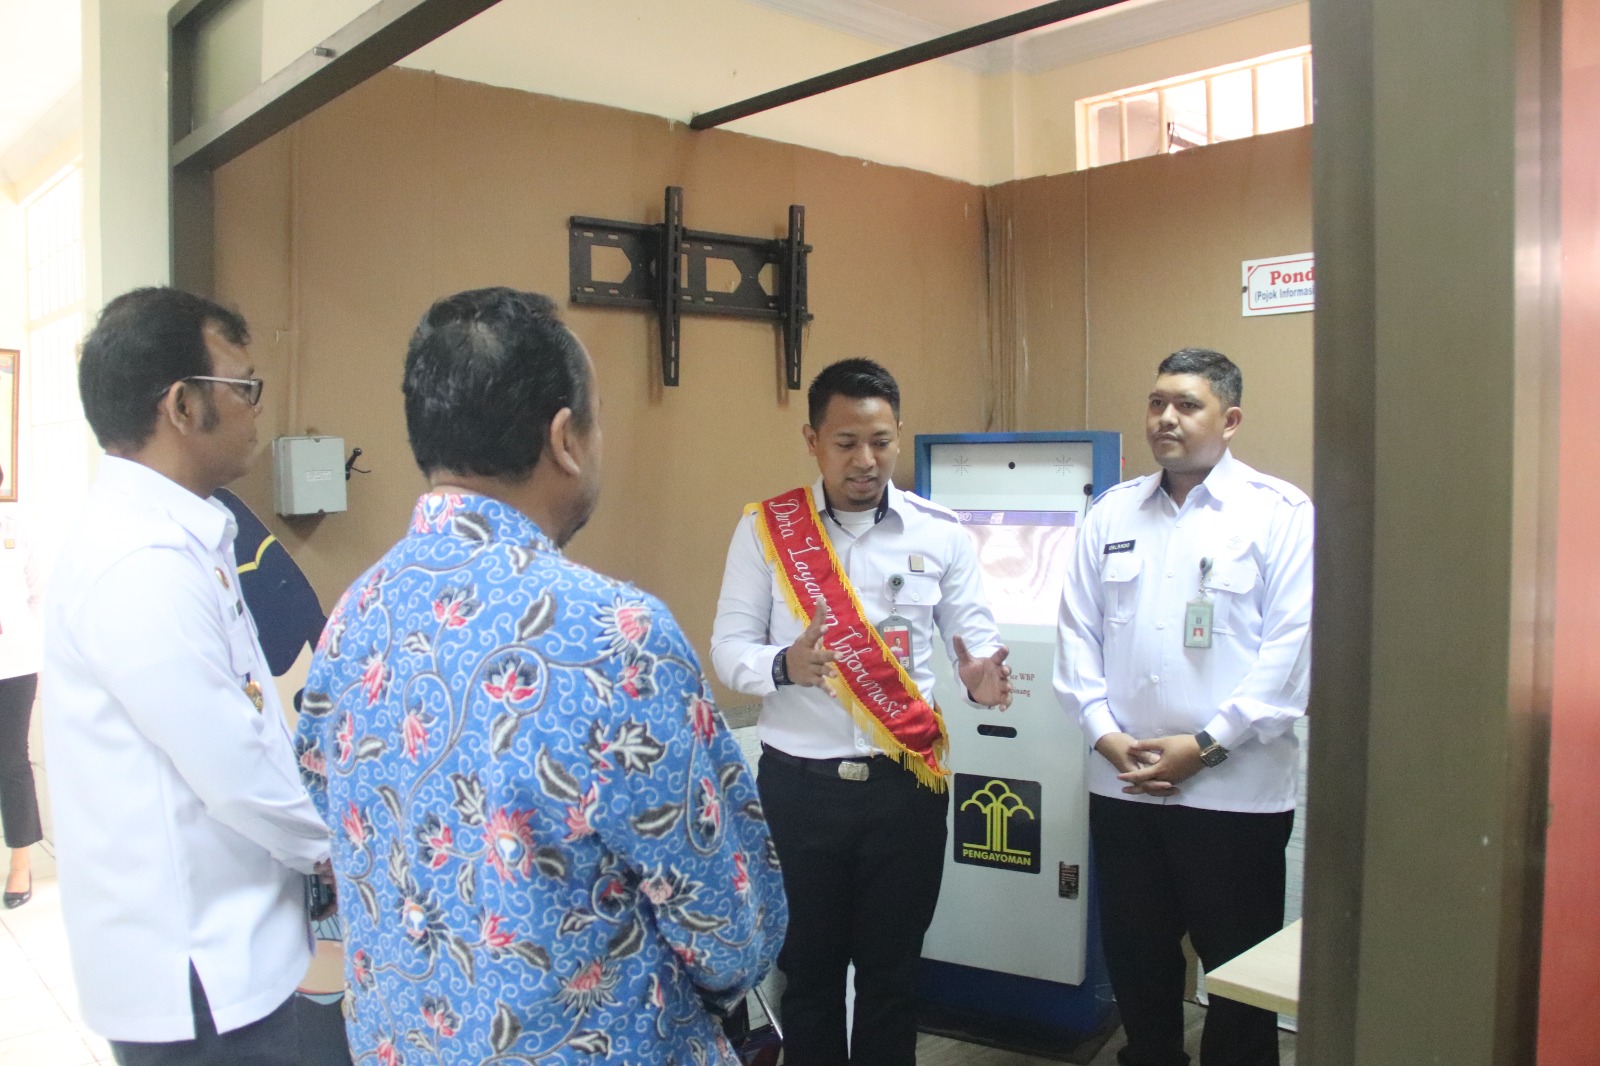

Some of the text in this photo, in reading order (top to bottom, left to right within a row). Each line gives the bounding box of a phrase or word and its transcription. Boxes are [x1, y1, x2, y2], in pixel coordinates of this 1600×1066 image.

[1255, 289, 1278, 303] (Pojok
[769, 498, 908, 719] Duta Layann Informasi
[962, 848, 1032, 866] PENGAYOMAN
